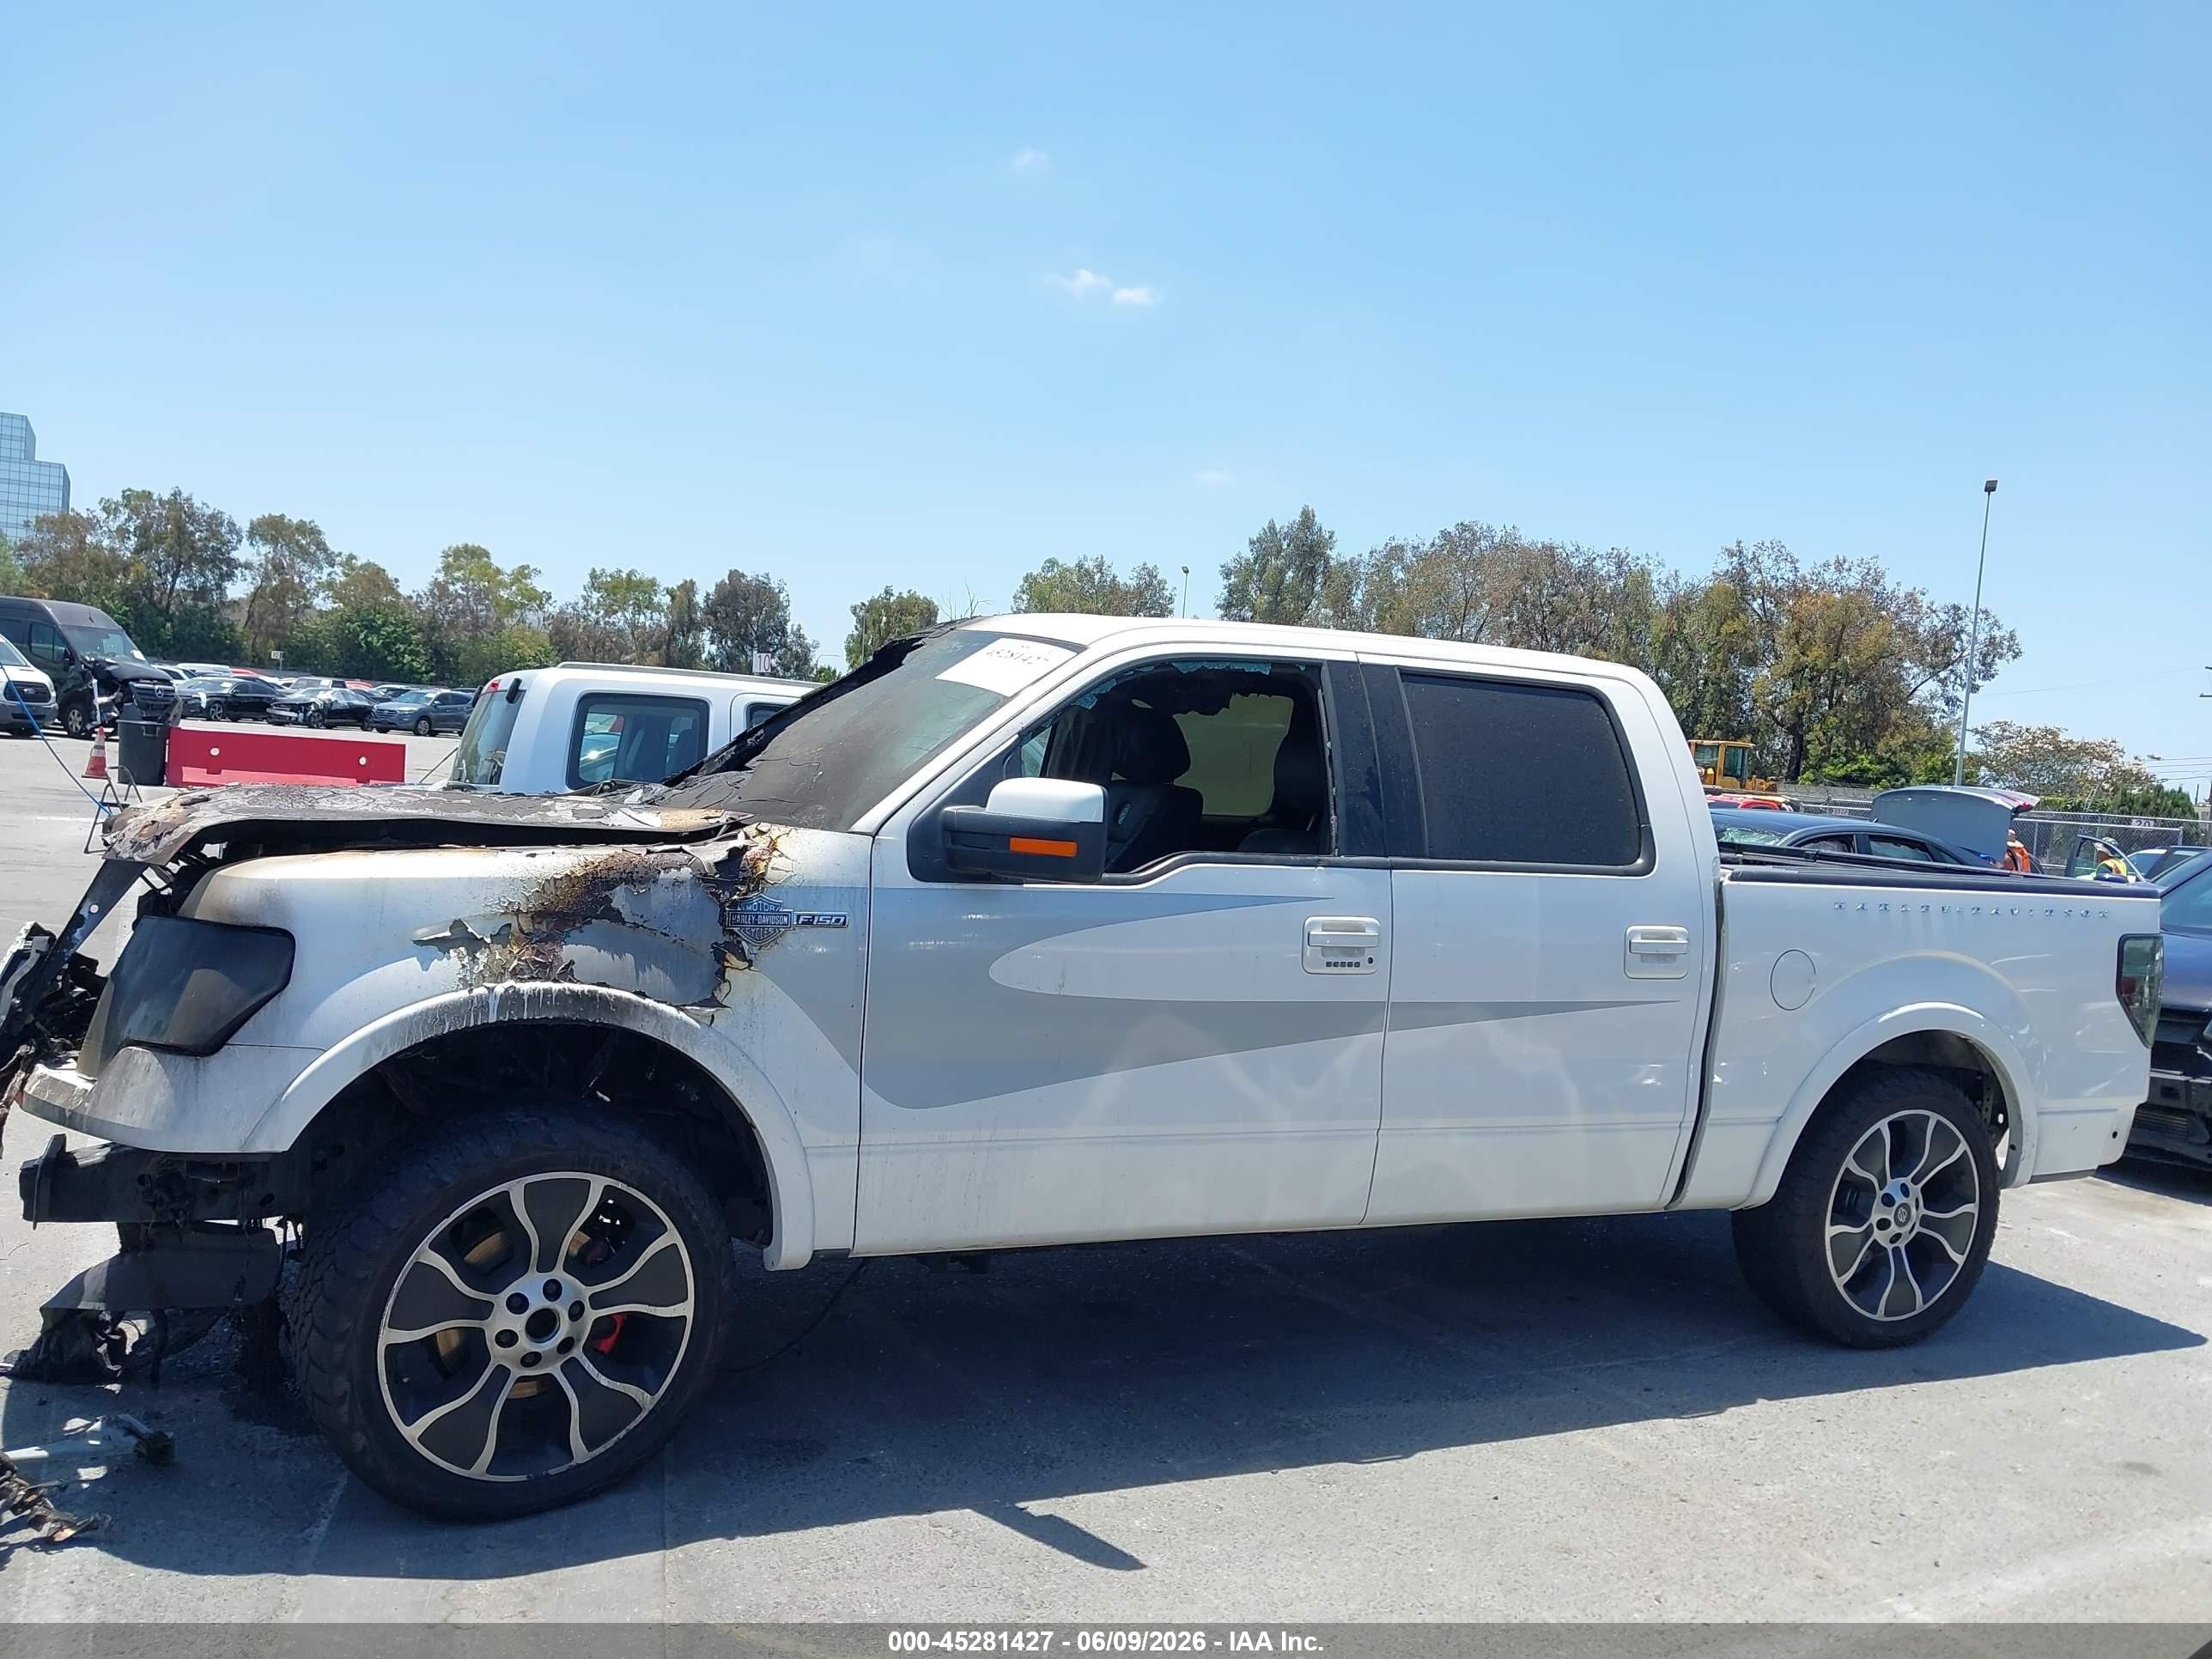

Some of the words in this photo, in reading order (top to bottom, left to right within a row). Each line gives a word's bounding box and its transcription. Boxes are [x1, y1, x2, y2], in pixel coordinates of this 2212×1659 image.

[757, 654, 770, 672] 10
[745, 902, 777, 912] MOTOR
[732, 913, 789, 926] HARLEY-DAVIDSON
[745, 927, 775, 939] CYCLES
